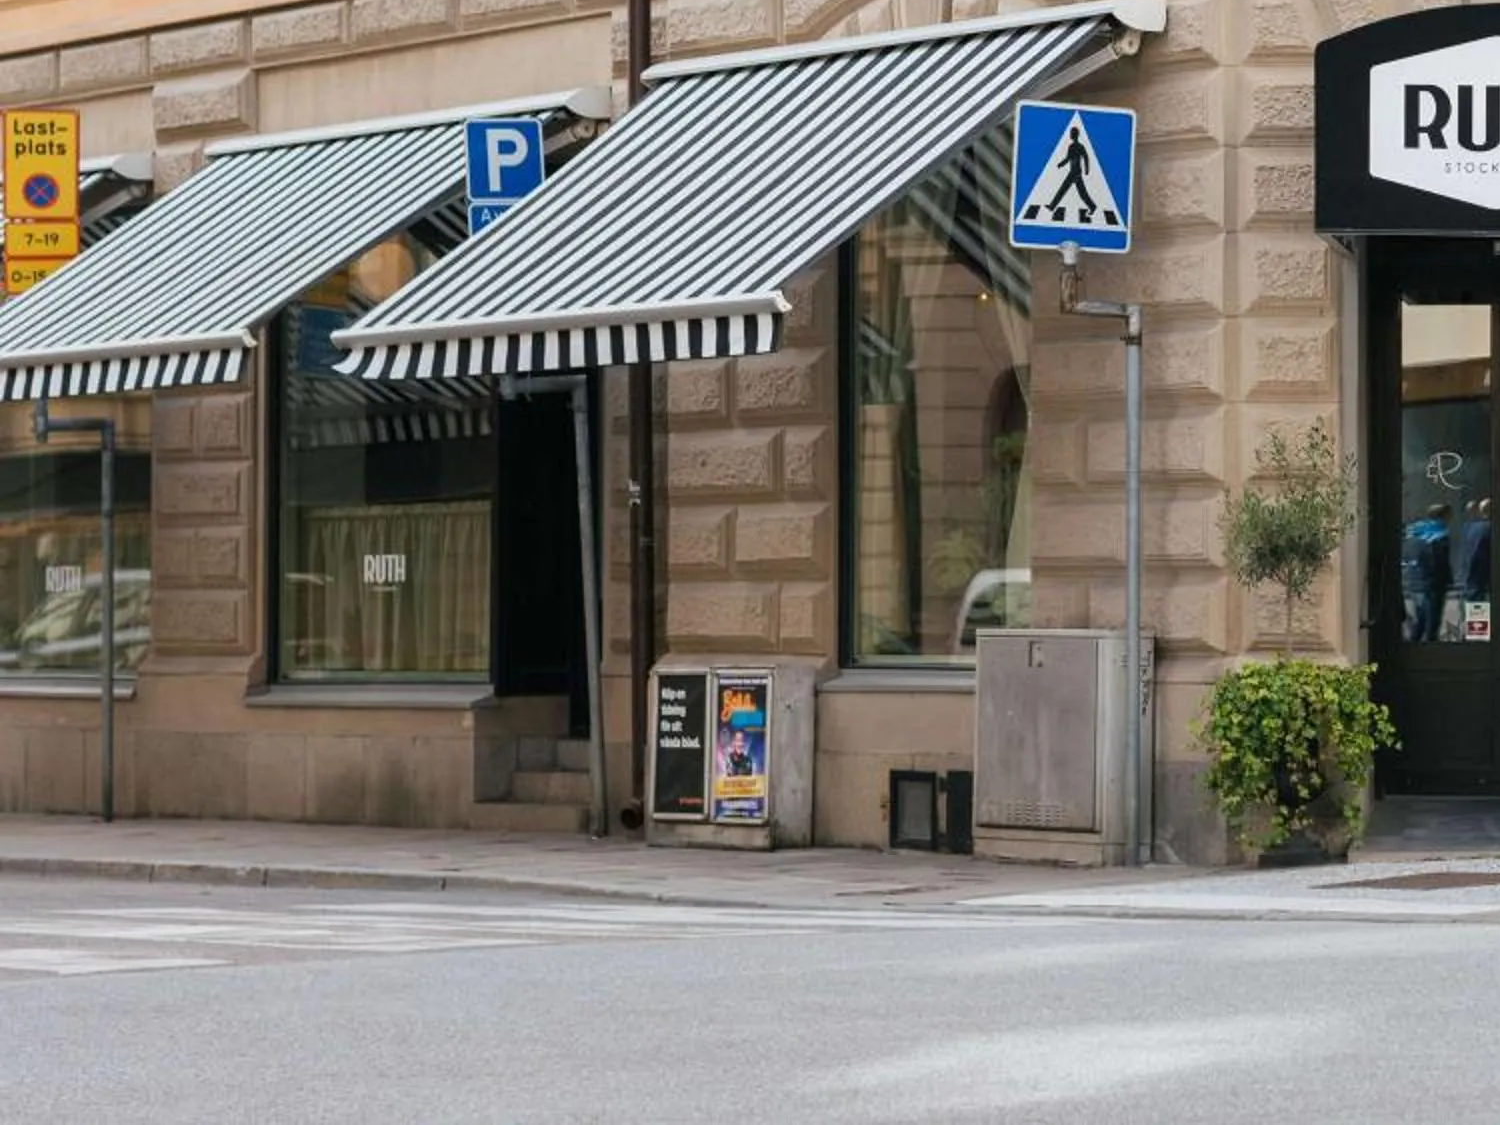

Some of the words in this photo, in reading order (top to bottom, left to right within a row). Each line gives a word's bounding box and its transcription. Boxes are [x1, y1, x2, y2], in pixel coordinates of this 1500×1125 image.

[13, 119, 68, 135] Last-
[14, 139, 67, 159] plats
[485, 127, 529, 193] P
[24, 232, 60, 248] 7-19
[44, 565, 82, 592] RUTH
[363, 554, 407, 584] RUTH
